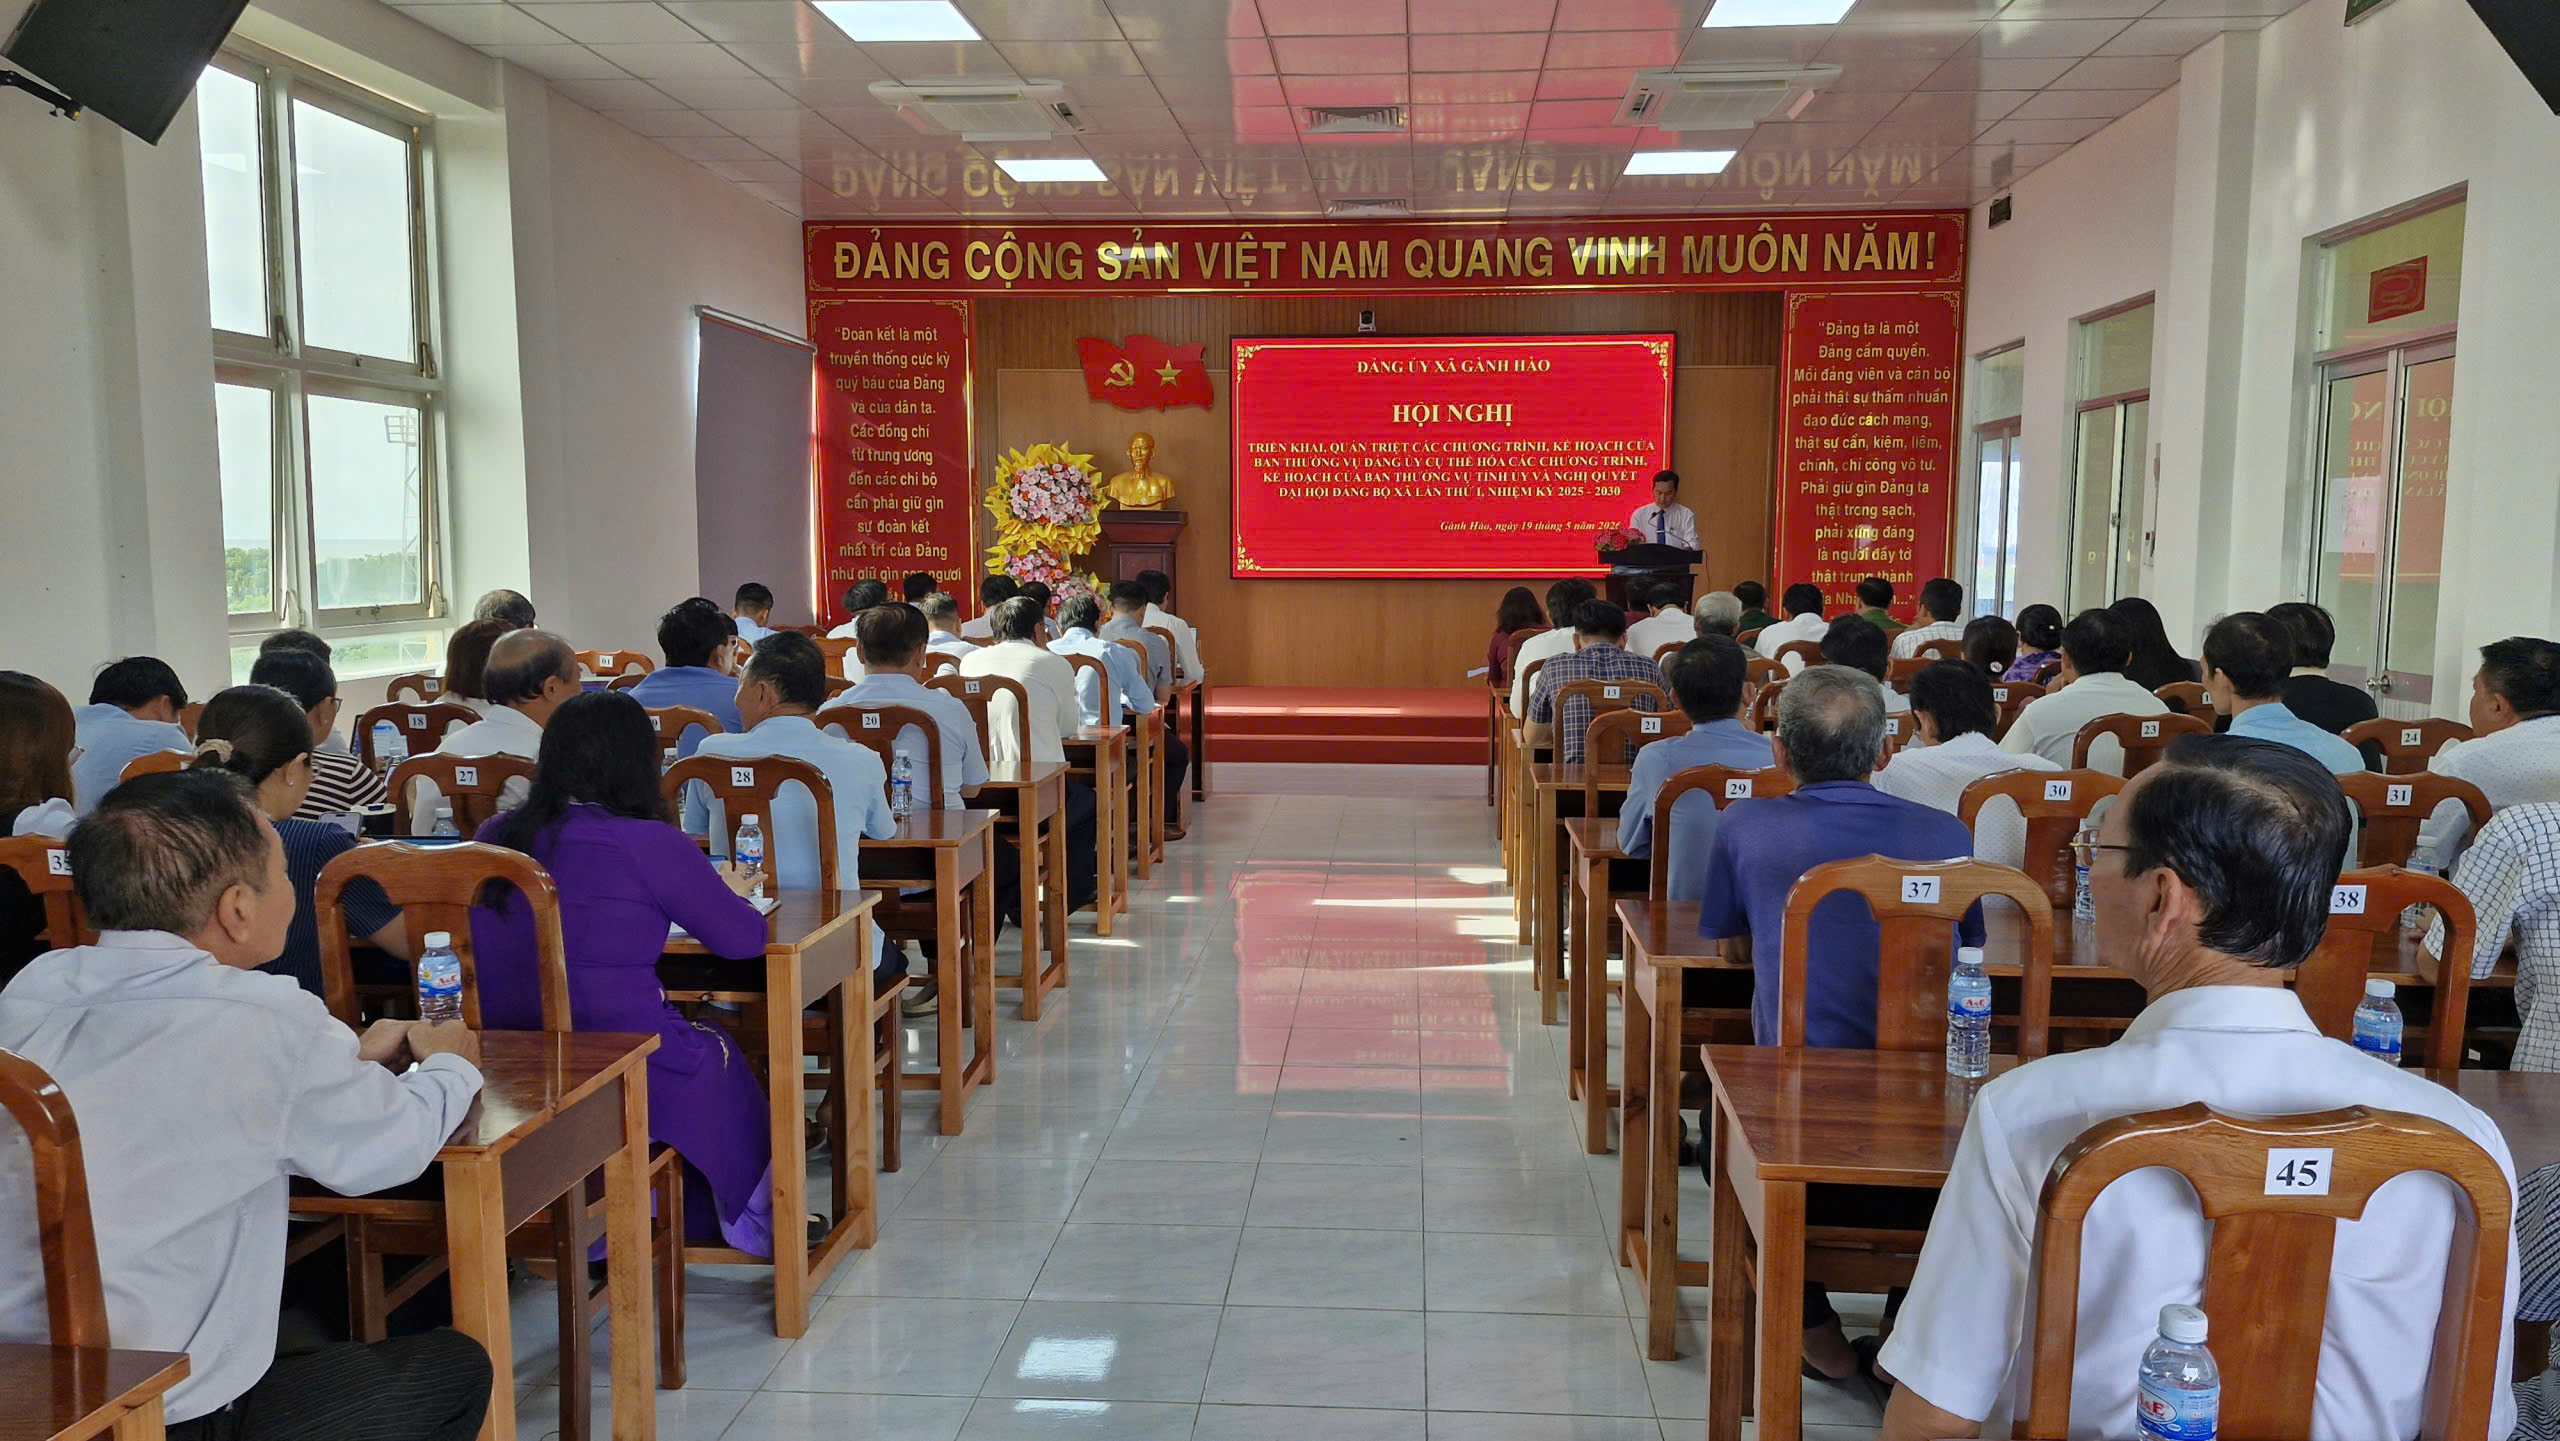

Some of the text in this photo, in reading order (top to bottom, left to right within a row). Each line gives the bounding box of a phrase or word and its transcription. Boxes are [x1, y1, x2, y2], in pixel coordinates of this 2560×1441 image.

[834, 221, 1935, 288] ĐẢNG CỘNG SẢN VIỆT NAM QUANG VINH MUÔN NĂM!
[1392, 401, 1513, 428] HỘI NGHỊ
[968, 683, 977, 691] 12
[1607, 689, 1617, 697] 13
[1996, 692, 2006, 700] 15
[412, 717, 424, 726] 18
[865, 717, 878, 726] 20
[1644, 721, 1656, 730] 21
[2143, 725, 2157, 735] 23
[2404, 733, 2417, 743] 24
[459, 770, 474, 782] 27
[735, 771, 751, 783] 28
[1730, 783, 1747, 795] 29
[2049, 784, 2067, 797] 30
[2389, 789, 2406, 802] 31
[1907, 882, 1932, 898] 37
[2334, 891, 2359, 908] 38
[2275, 1159, 2319, 1187] 45
